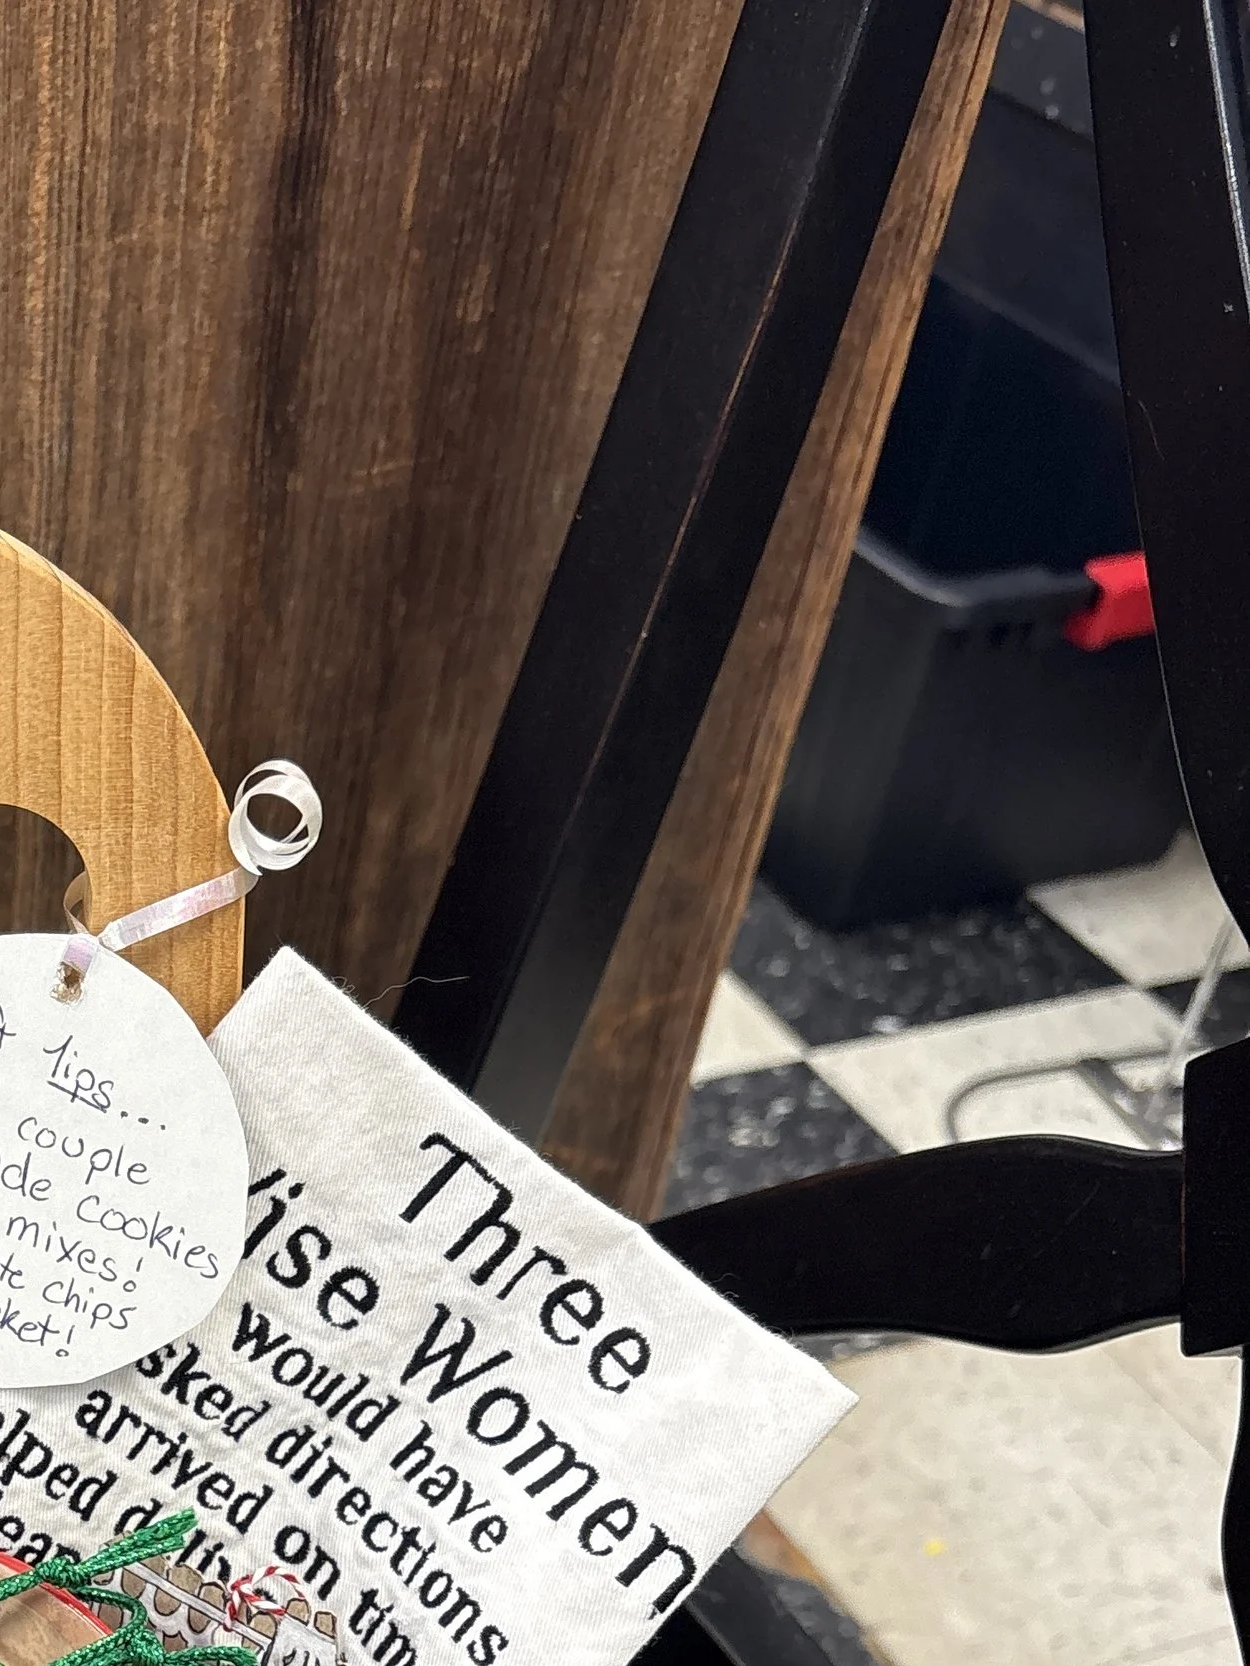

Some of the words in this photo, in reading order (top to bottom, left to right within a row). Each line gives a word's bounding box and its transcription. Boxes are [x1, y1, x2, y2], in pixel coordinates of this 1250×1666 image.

[17, 1117, 150, 1185] couple
[7, 1216, 143, 1293] mixes!
[43, 1278, 137, 1330] chips
[399, 1132, 651, 1395] Three
[135, 1340, 272, 1443] sked
[232, 1301, 403, 1443] would
[389, 1420, 508, 1554] have
[244, 1167, 381, 1331] ise
[400, 1302, 697, 1621] Women
[74, 1388, 274, 1536] arrived
[273, 1524, 340, 1601] on
